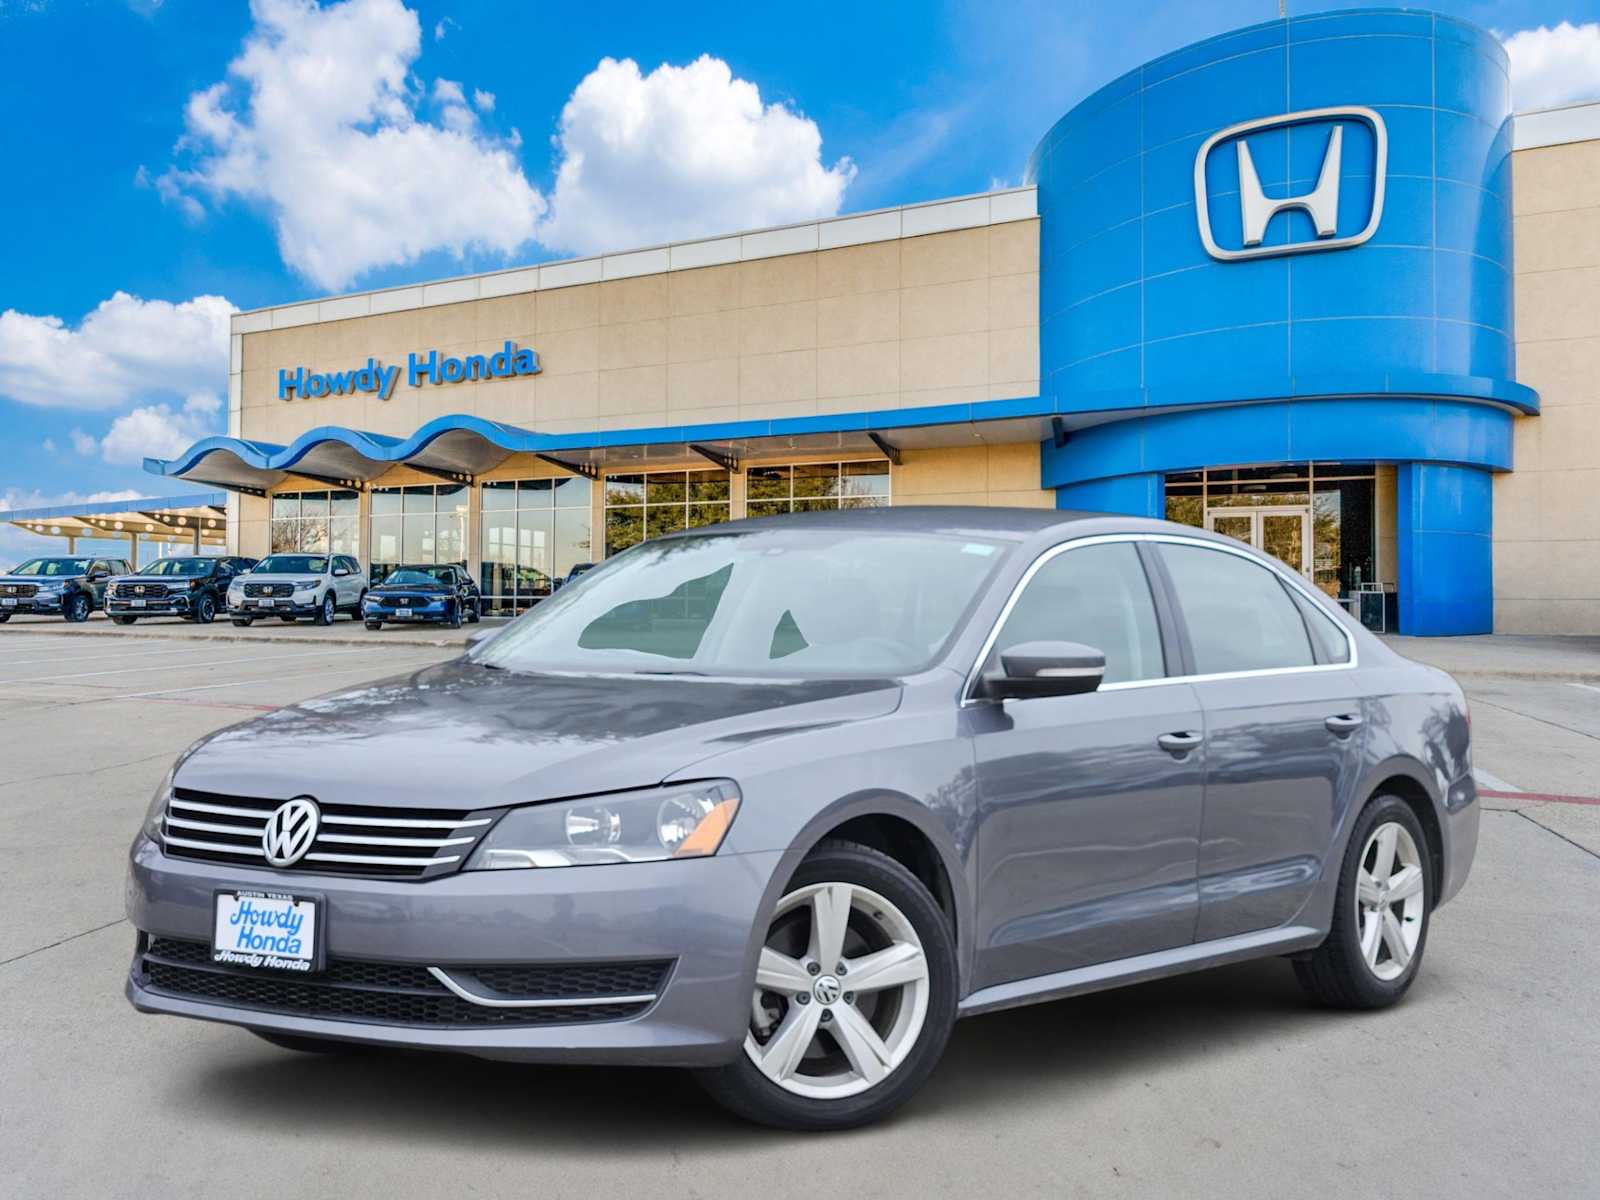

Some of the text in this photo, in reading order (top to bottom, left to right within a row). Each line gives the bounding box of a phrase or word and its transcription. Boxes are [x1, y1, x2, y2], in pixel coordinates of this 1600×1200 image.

[279, 341, 542, 401] Howdy Honda
[237, 890, 265, 898] AUSTIN
[230, 900, 304, 935] Howdy
[237, 926, 301, 954] Honda
[214, 950, 310, 971] Howdy Honda
